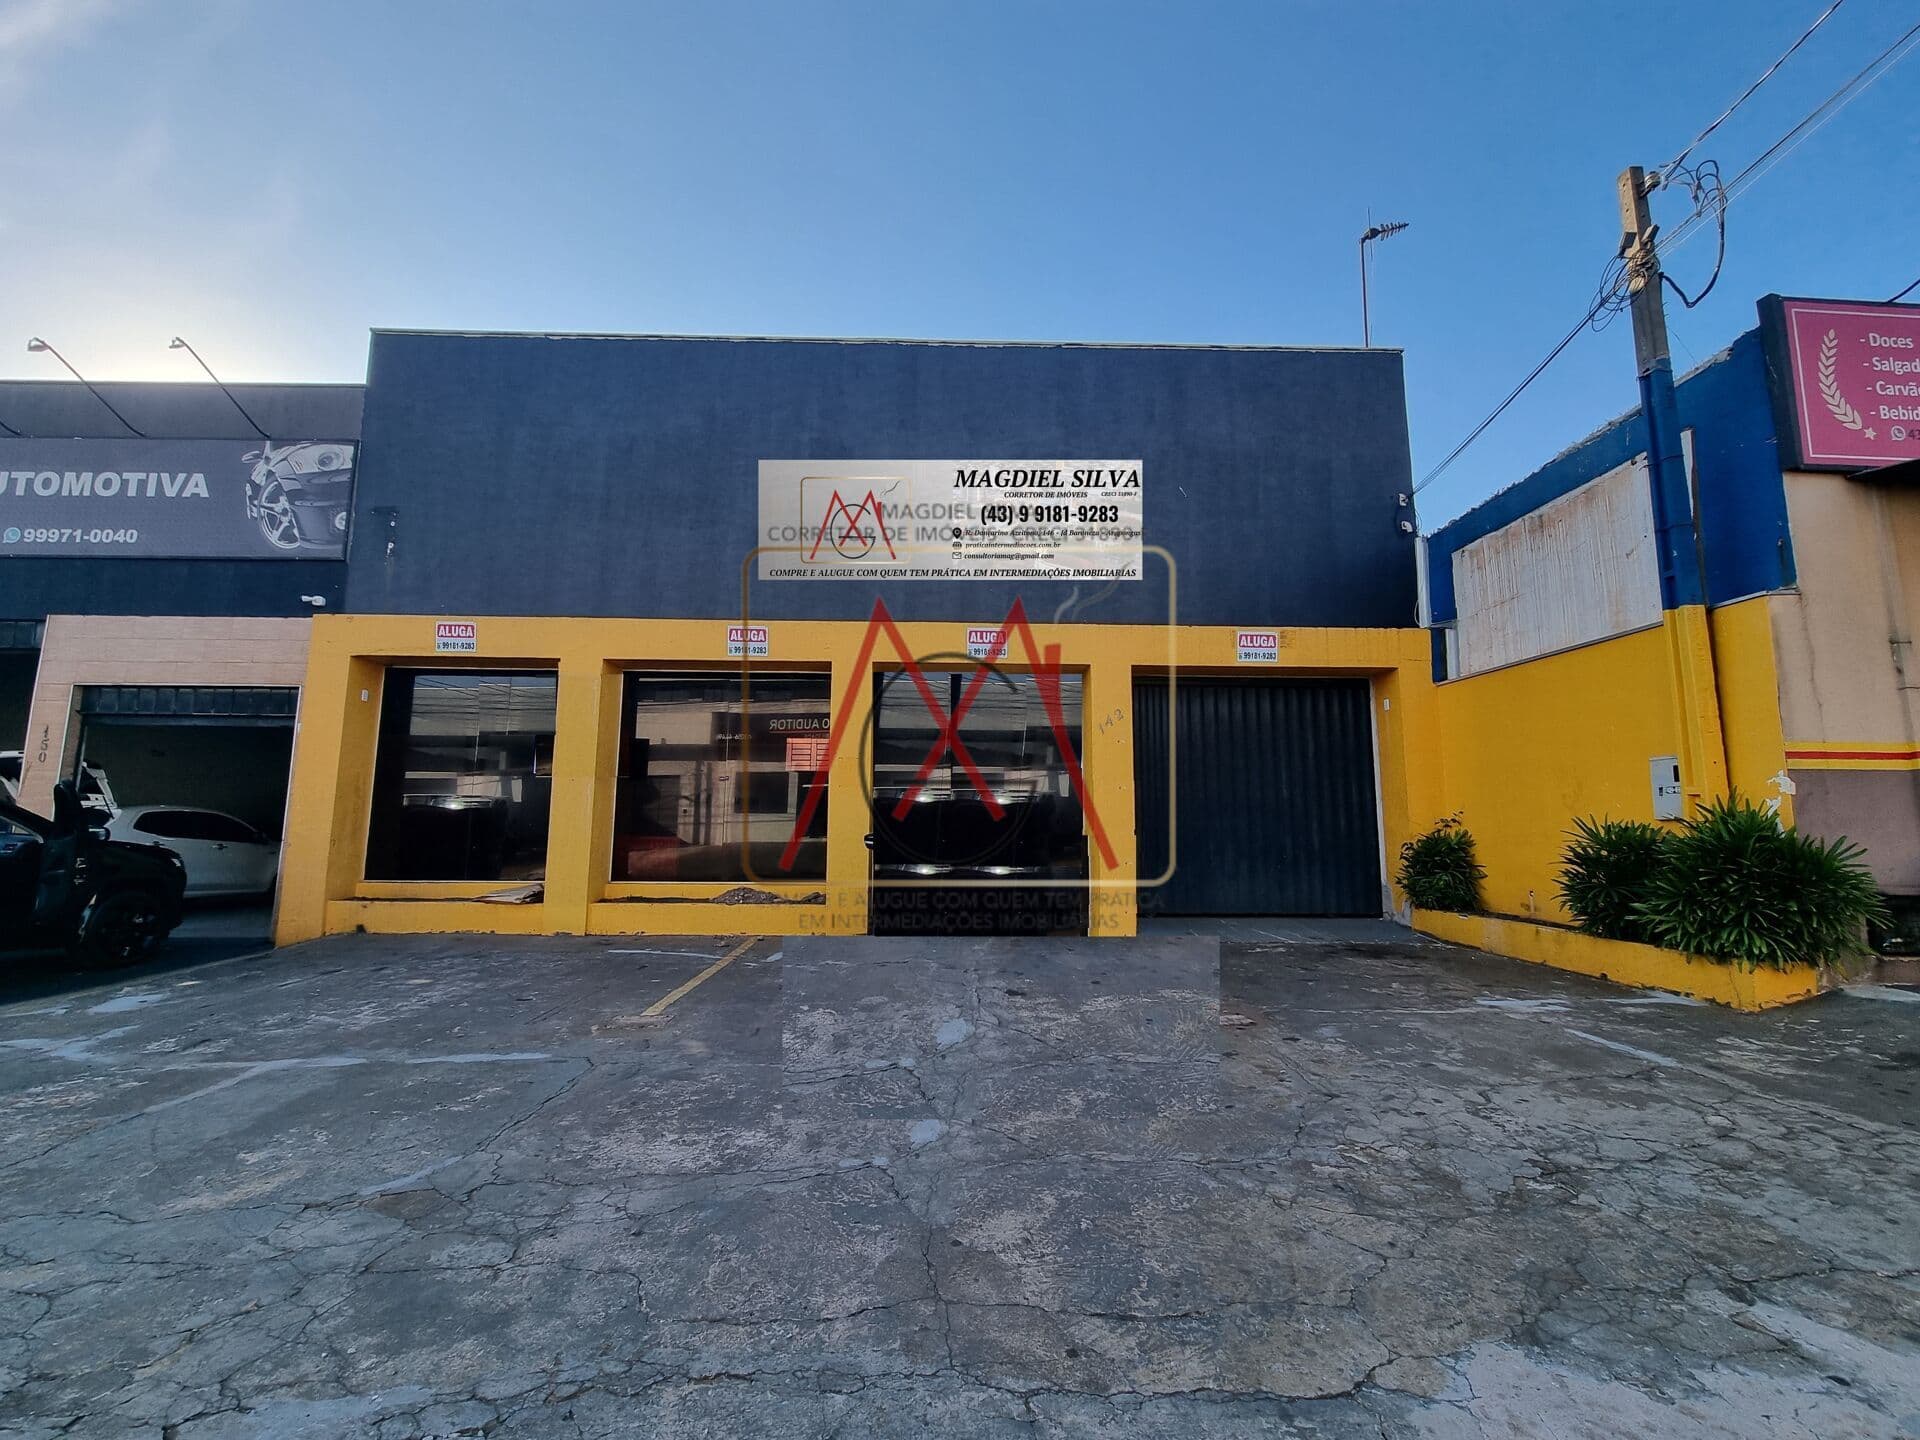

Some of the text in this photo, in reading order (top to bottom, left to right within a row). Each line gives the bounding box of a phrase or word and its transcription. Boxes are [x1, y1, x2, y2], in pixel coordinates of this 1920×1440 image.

[1868, 333, 1914, 348] Doces
[1876, 381, 1920, 396] Carvã
[23, 529, 138, 543] 99971-0040
[438, 625, 474, 637] ALUGA
[730, 630, 766, 642] ALUGA
[969, 631, 1005, 643] ALUGA
[1240, 635, 1275, 647] ALUGA
